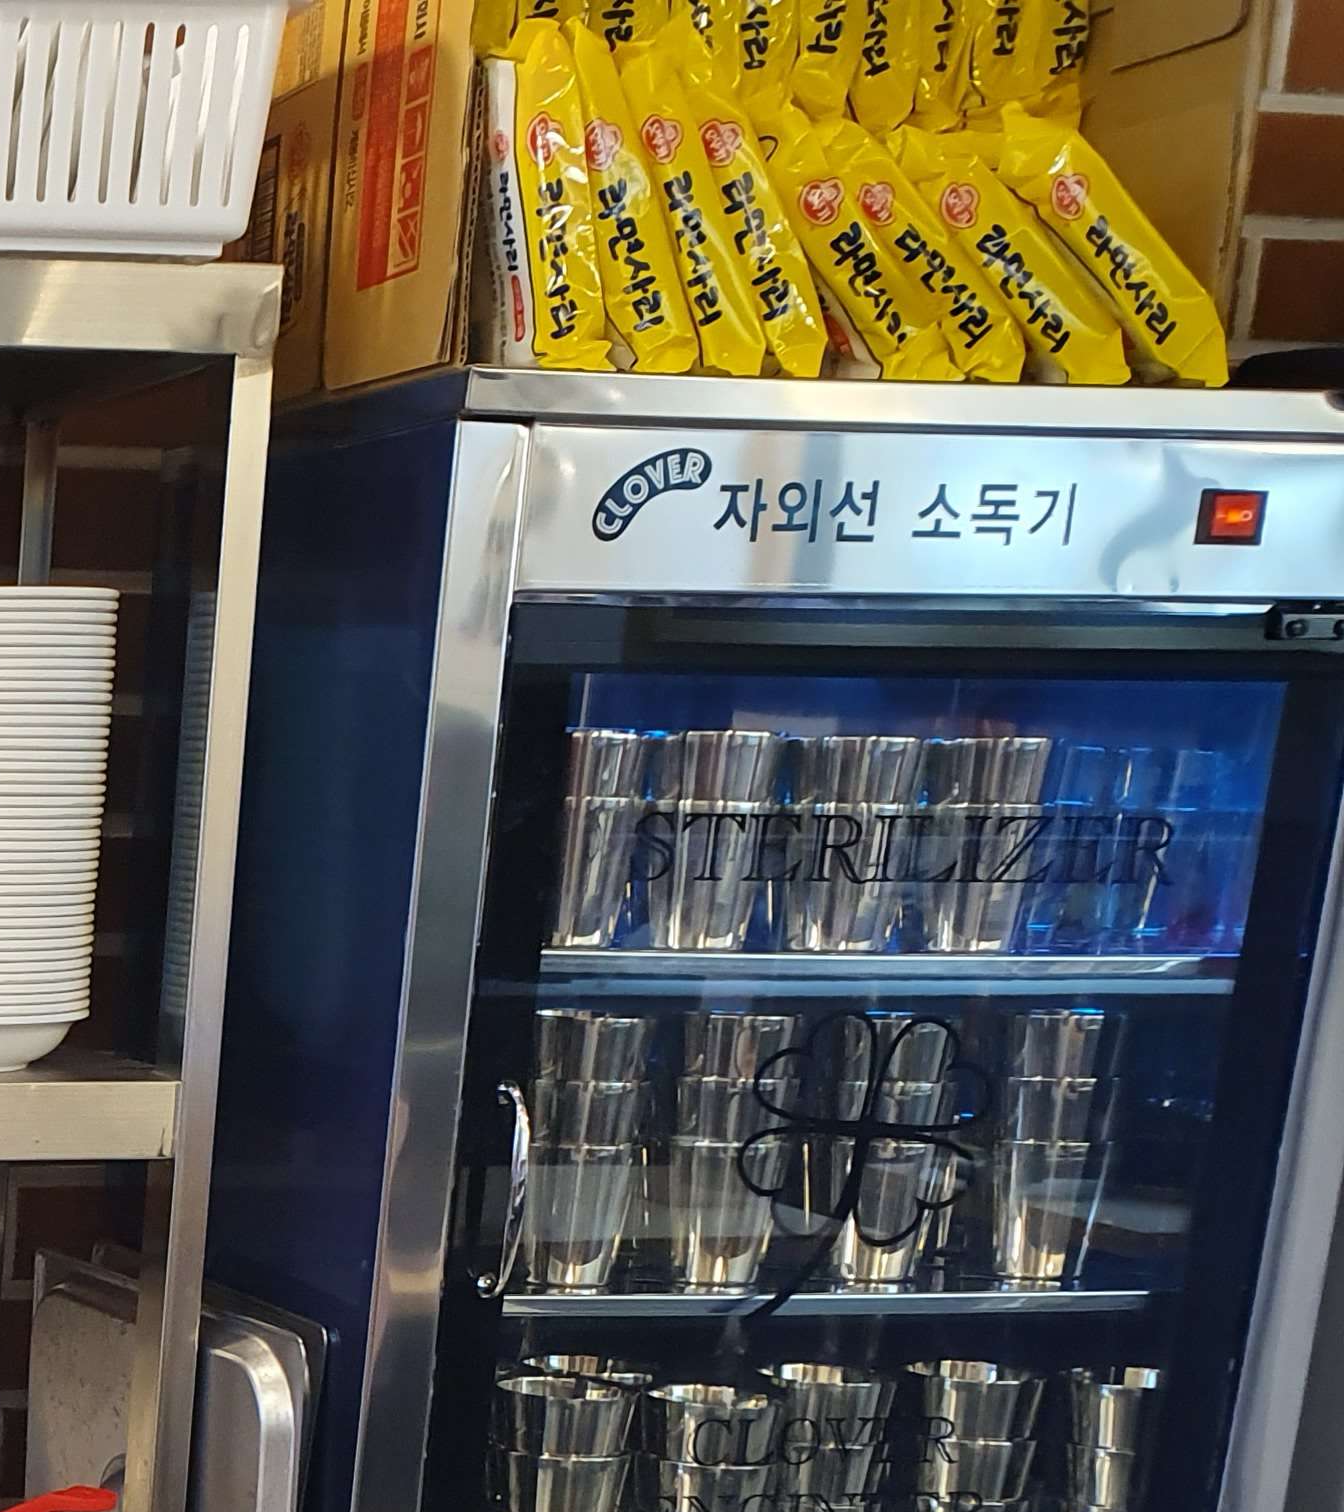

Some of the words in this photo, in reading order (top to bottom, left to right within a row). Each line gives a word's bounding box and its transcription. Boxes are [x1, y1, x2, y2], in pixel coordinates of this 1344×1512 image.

[597, 177, 665, 333] 라면사리
[663, 170, 723, 328] 라면사리
[720, 171, 791, 322] 라면사리
[894, 222, 993, 350] 라면사리
[975, 224, 1072, 354] 라면사리
[1085, 215, 1178, 346] 라면사리
[594, 450, 706, 538] CLOVER
[712, 479, 882, 544] 자외선
[911, 481, 1079, 547] 소독기
[632, 811, 1176, 887] STERILIZER
